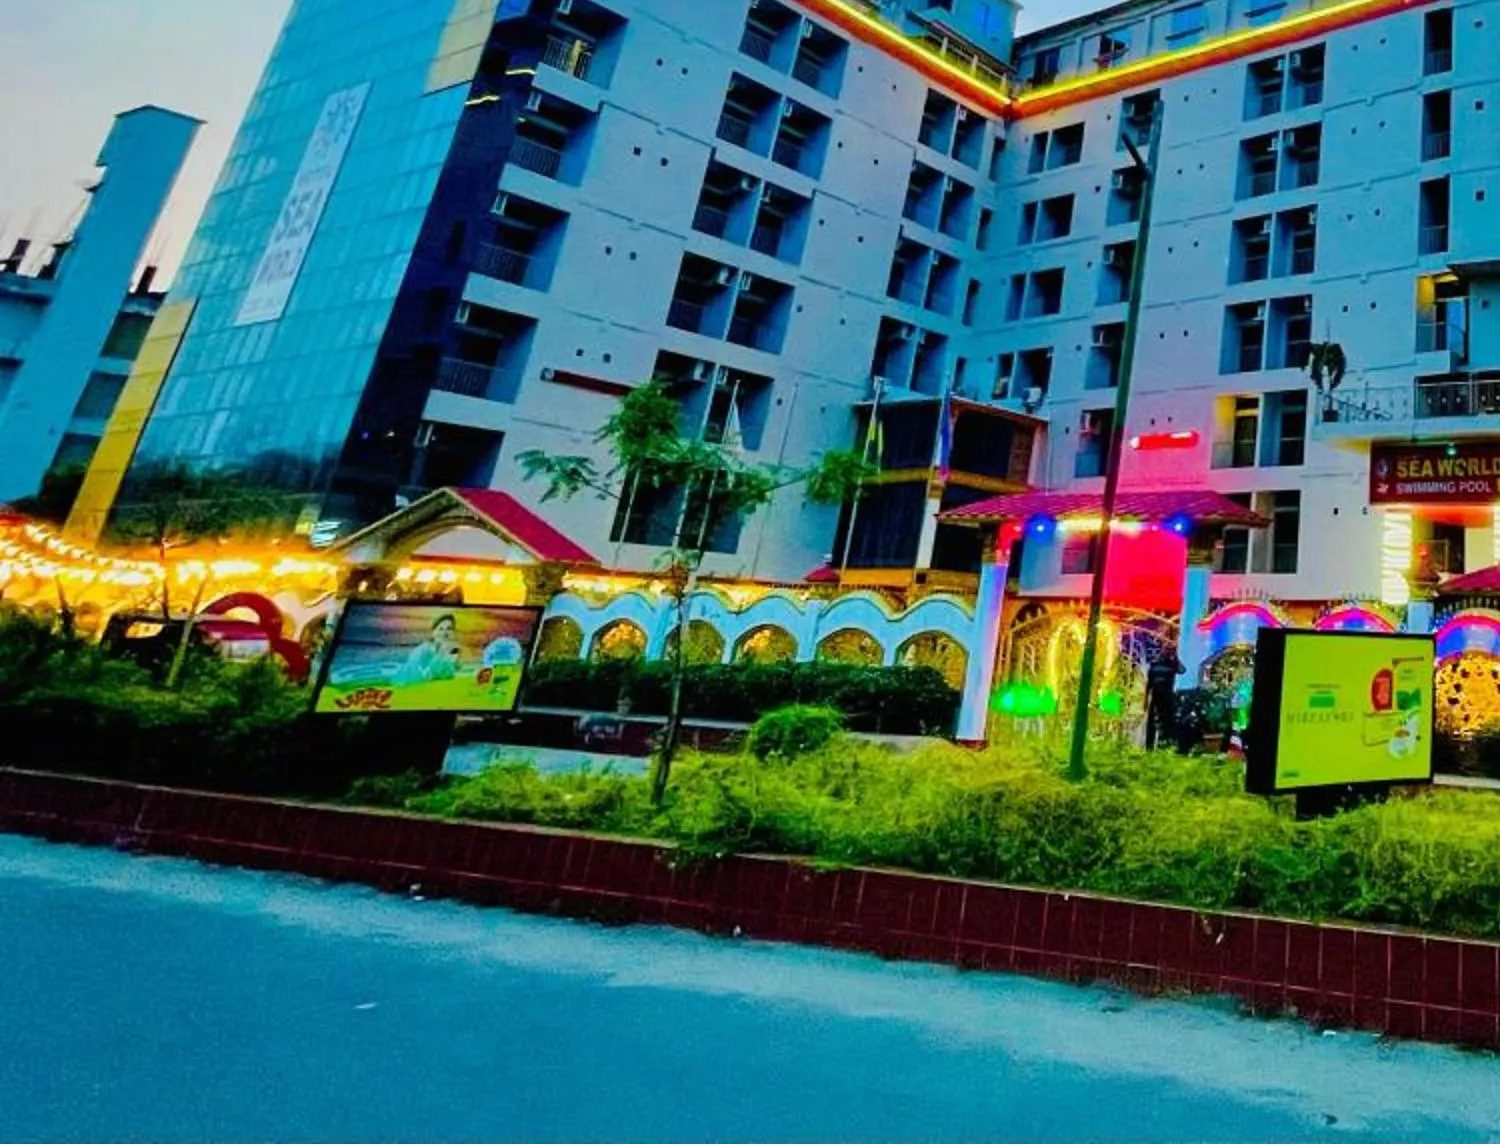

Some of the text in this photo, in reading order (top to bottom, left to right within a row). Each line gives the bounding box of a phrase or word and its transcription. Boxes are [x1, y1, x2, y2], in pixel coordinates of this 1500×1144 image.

[1396, 459, 1434, 478] SEA
[1396, 479, 1492, 495] SWIMMING POOL
